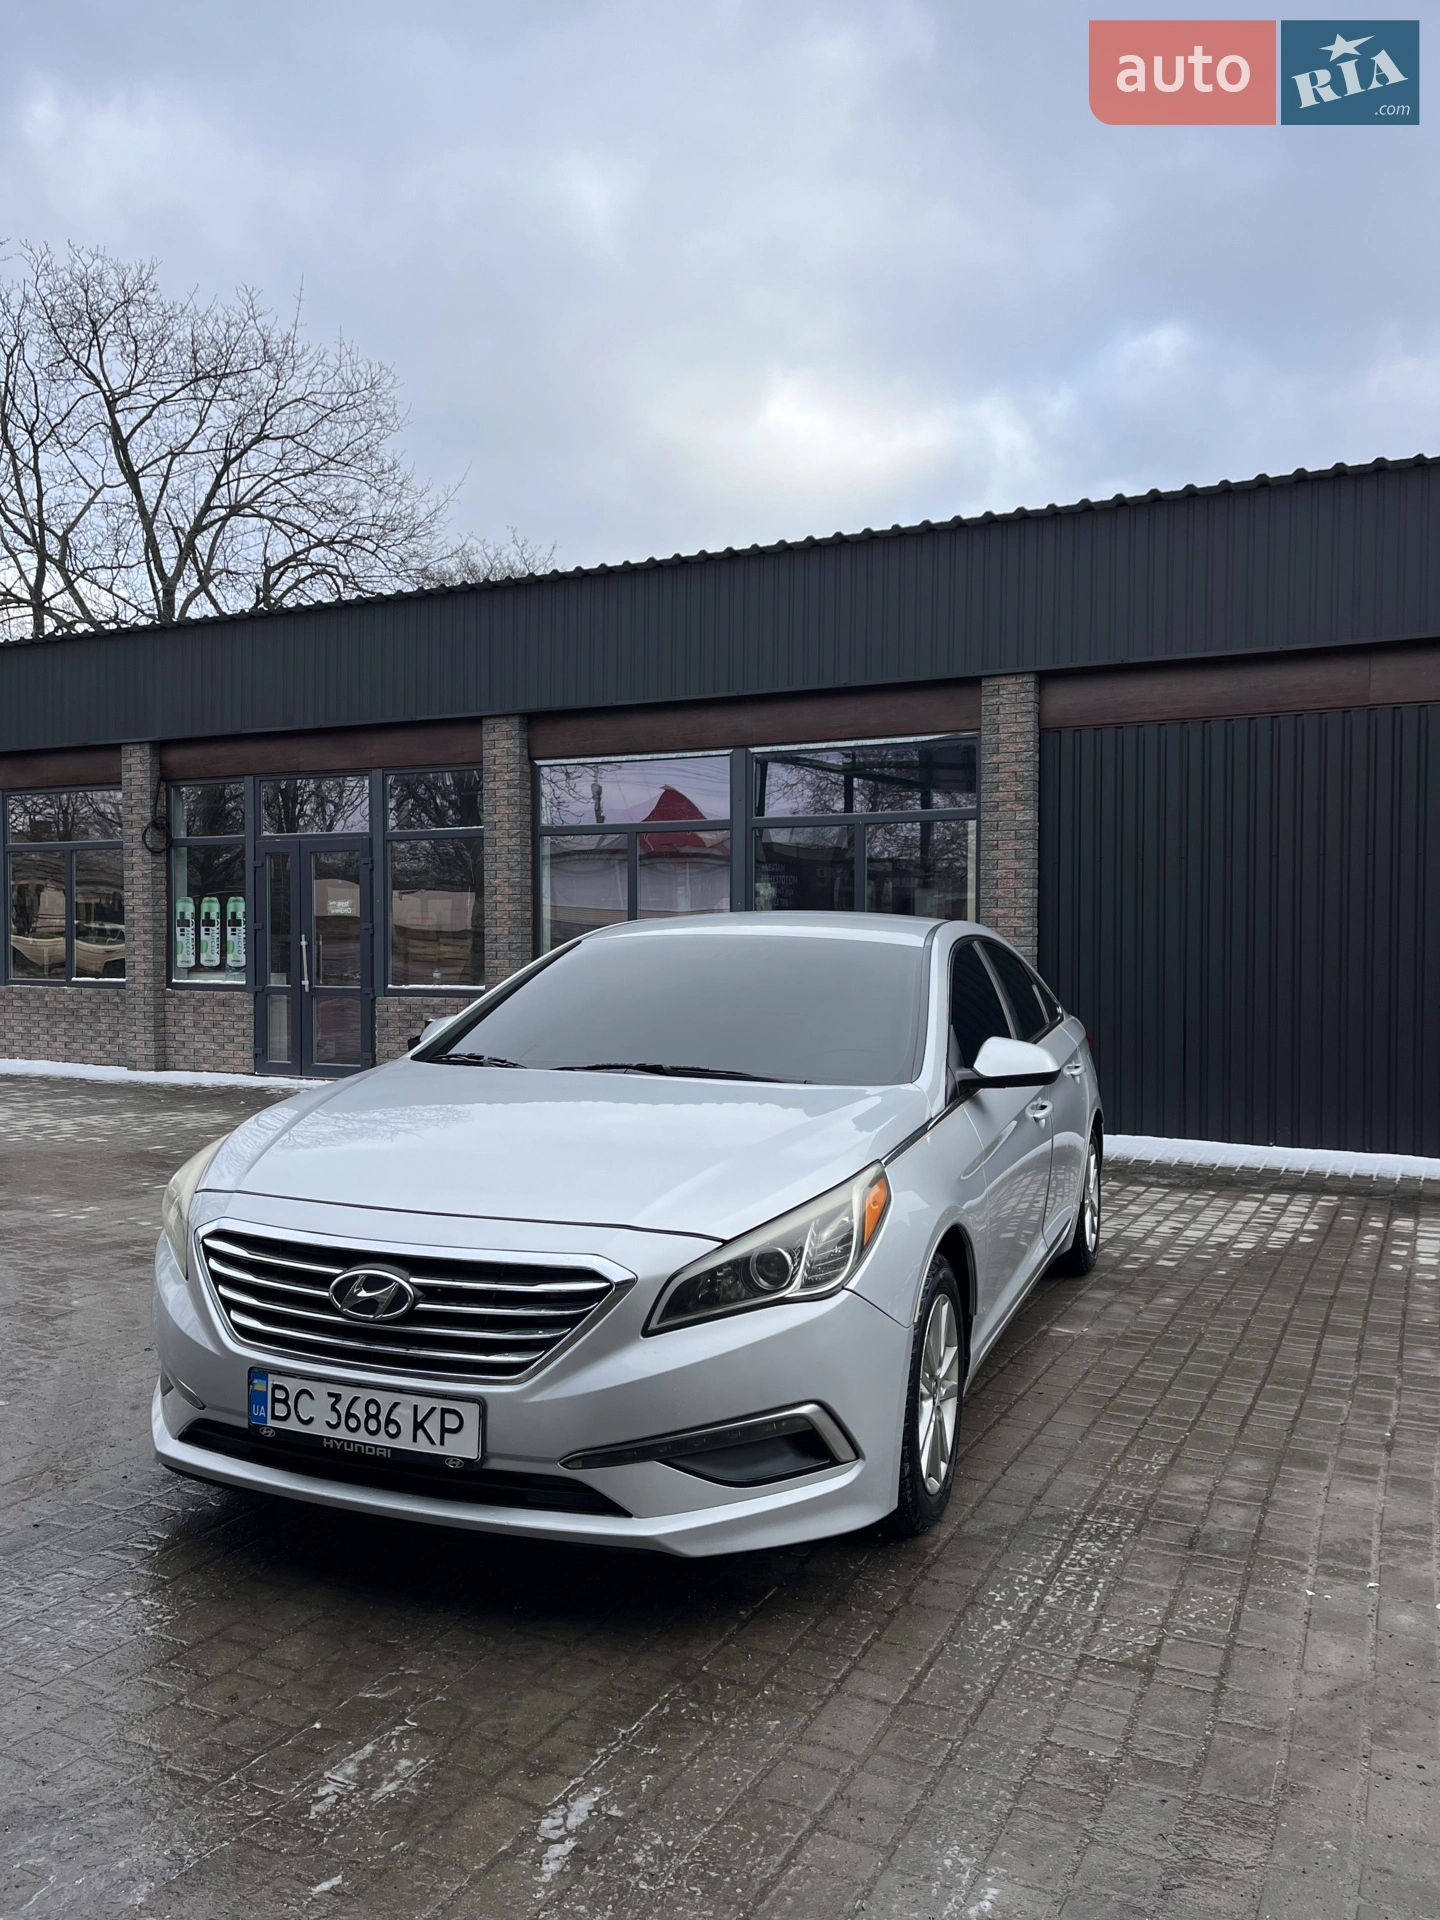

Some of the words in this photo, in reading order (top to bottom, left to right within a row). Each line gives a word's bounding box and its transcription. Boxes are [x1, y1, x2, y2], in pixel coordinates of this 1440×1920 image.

[252, 1403, 266, 1418] UA
[270, 1383, 315, 1426] BC
[325, 1391, 402, 1439] 3686
[412, 1404, 465, 1446] KP
[323, 1438, 391, 1459] HYUNDAI
